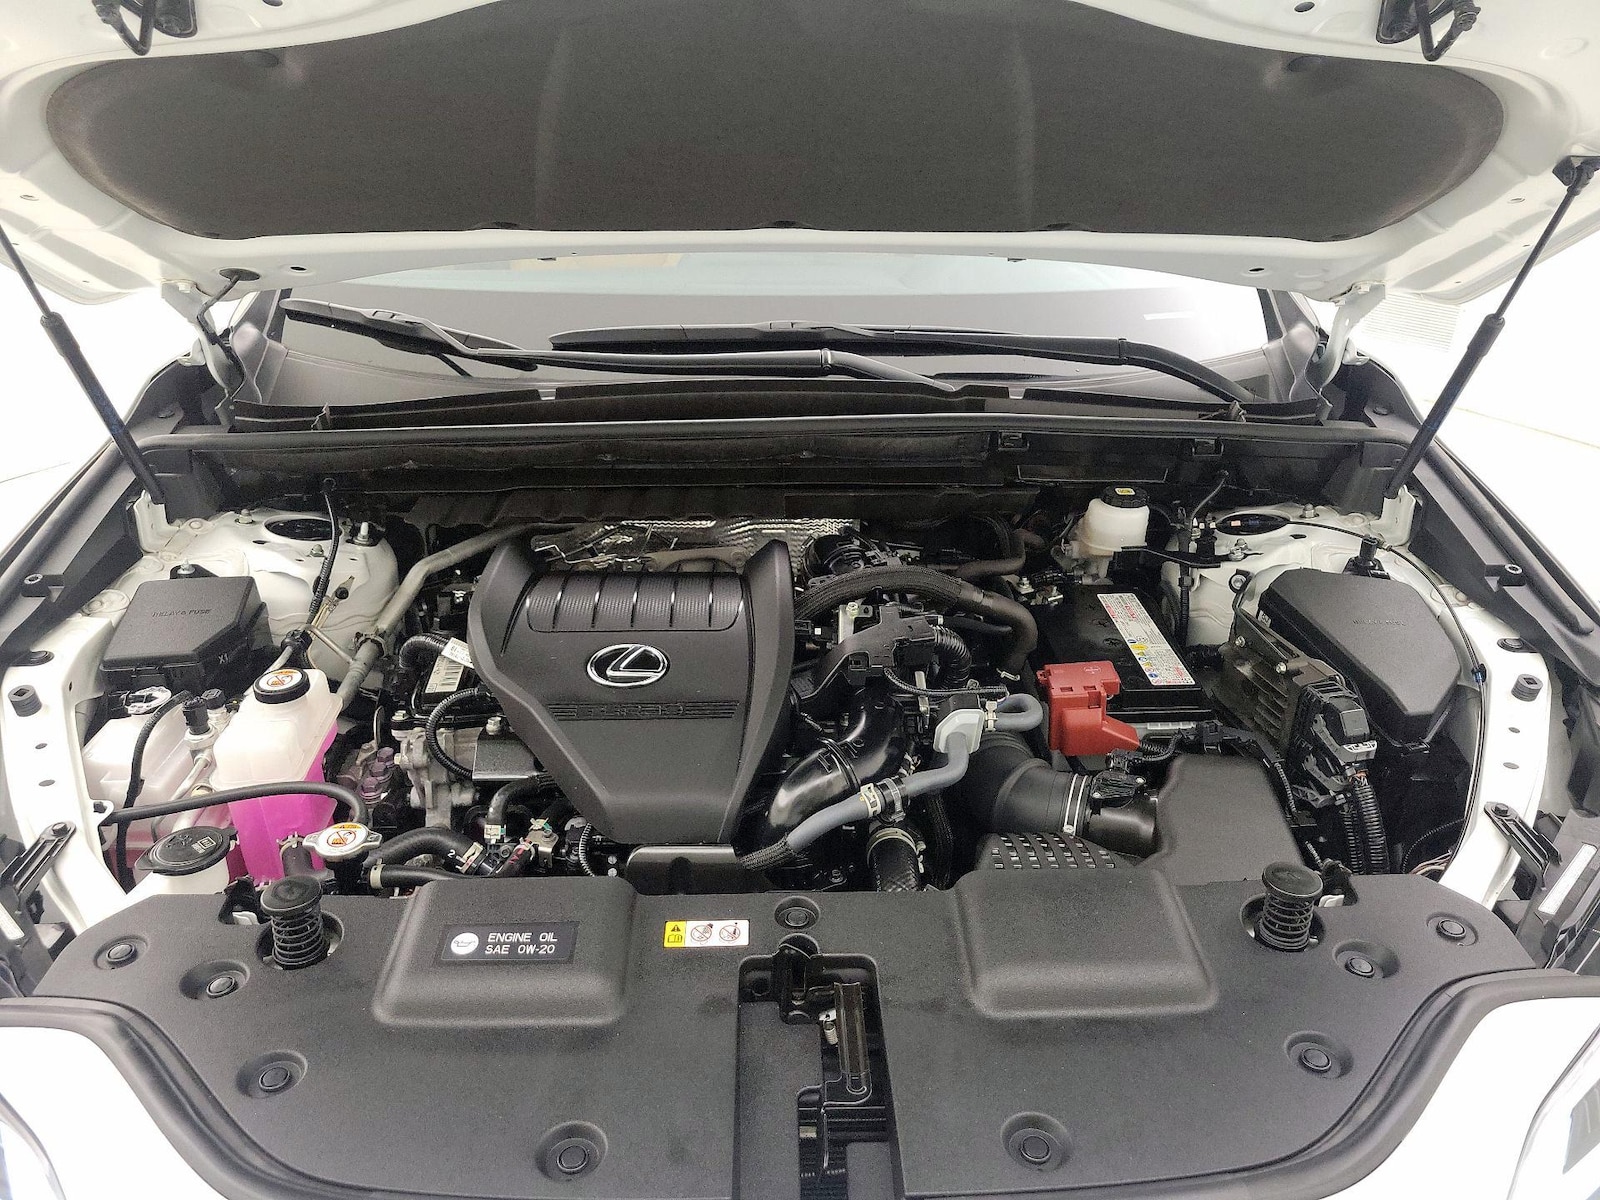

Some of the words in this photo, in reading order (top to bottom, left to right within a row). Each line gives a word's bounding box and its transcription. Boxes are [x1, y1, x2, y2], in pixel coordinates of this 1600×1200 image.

[487, 932, 533, 943] ENGINE
[539, 932, 558, 943] OIL
[484, 944, 511, 955] SAE
[517, 944, 556, 955] 0W-20
